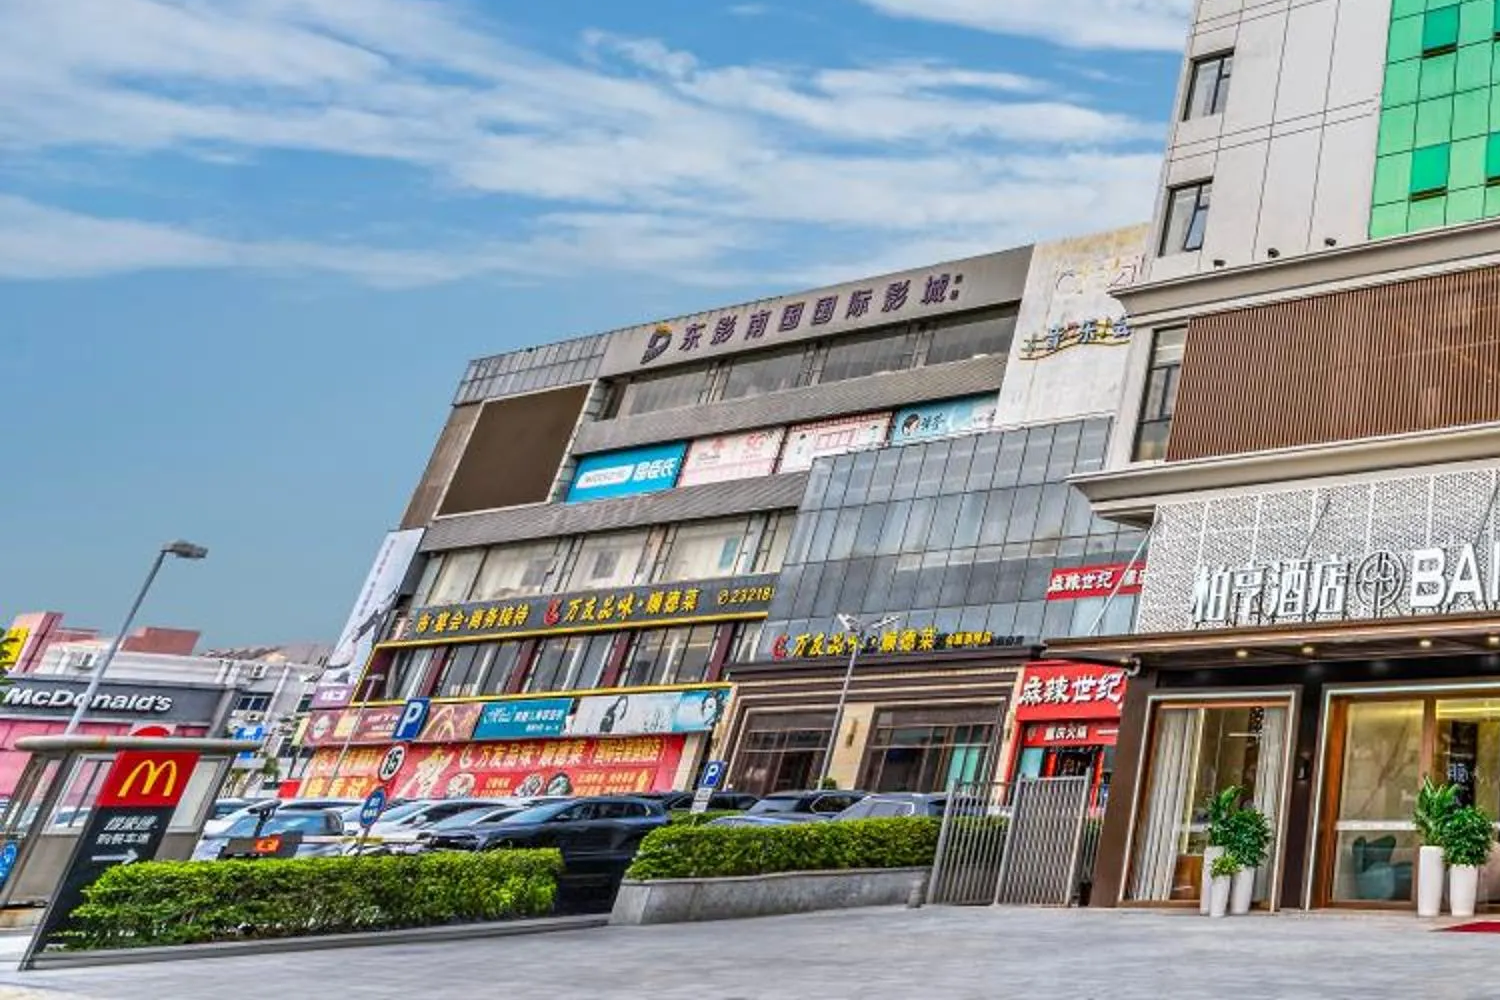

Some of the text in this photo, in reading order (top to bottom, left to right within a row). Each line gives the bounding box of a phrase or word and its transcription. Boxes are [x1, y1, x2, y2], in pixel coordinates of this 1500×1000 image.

[1193, 553, 1350, 623] 柏亨酒店
[4, 687, 173, 711] McDonald's
[1019, 671, 1123, 706] 麻辣世纪
[396, 702, 423, 737] P
